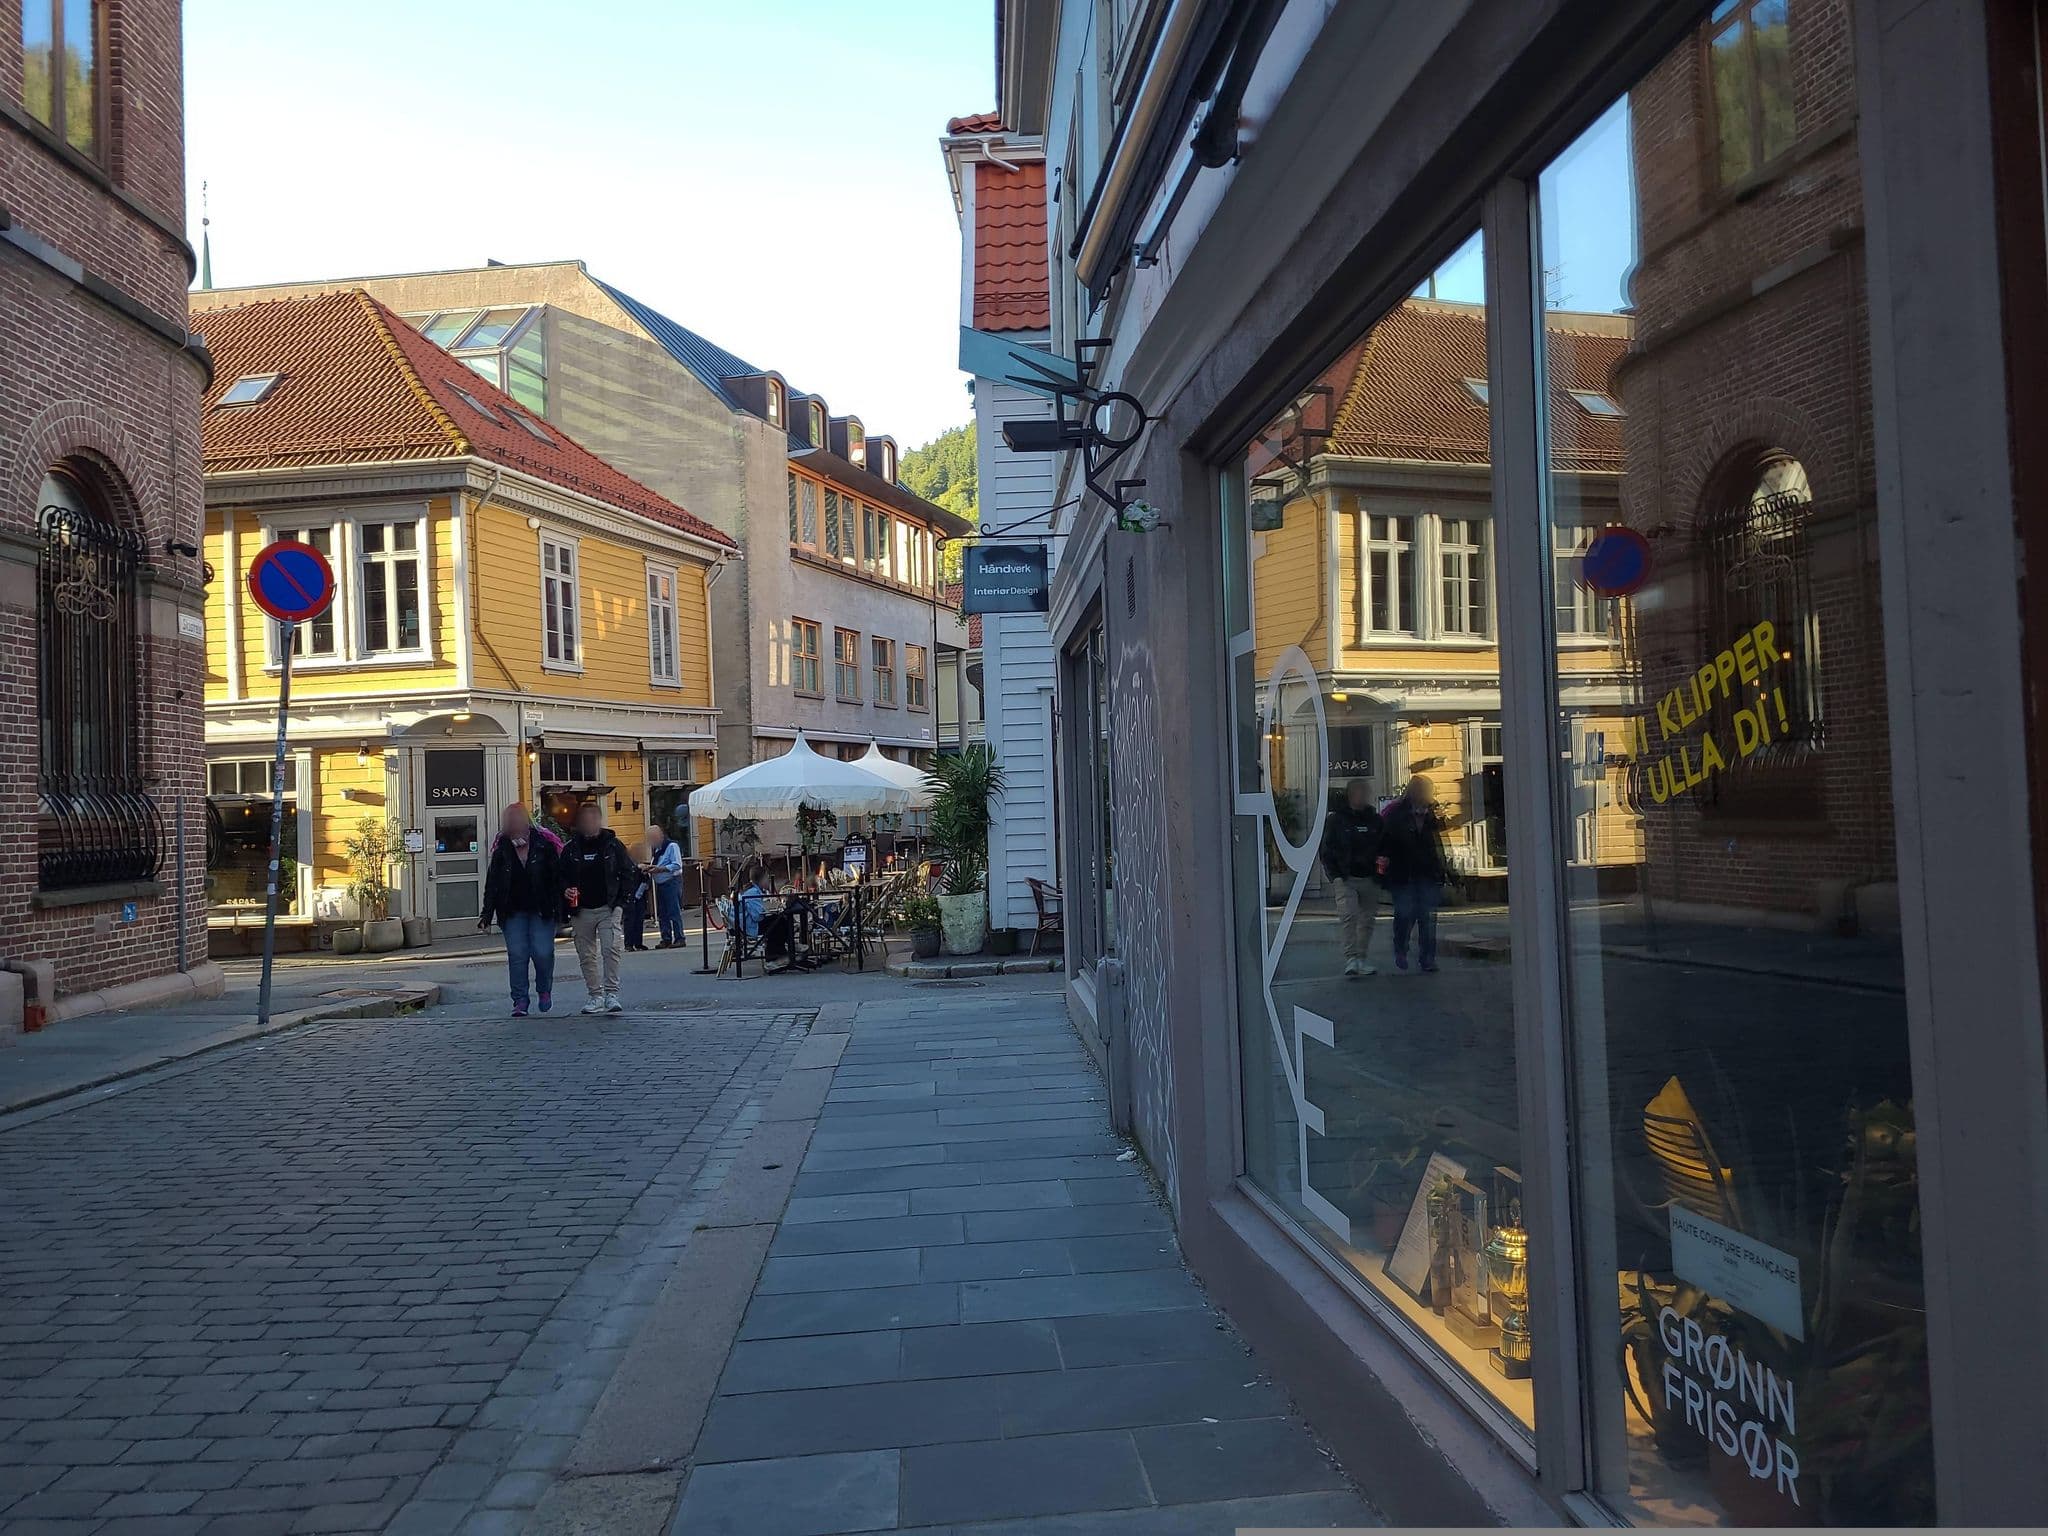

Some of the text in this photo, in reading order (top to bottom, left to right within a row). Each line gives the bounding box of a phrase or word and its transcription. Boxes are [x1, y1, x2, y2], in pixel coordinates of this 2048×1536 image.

[979, 564, 1031, 574] Håndverk
[1656, 621, 1780, 741] KLIPPER
[1647, 731, 1726, 804] ULLA
[1671, 1216, 1699, 1239] HAUTE
[1700, 1230, 1742, 1259] COIFFURE
[1658, 1306, 1796, 1435] GRØNN
[1663, 1362, 1801, 1508] FRISØR
